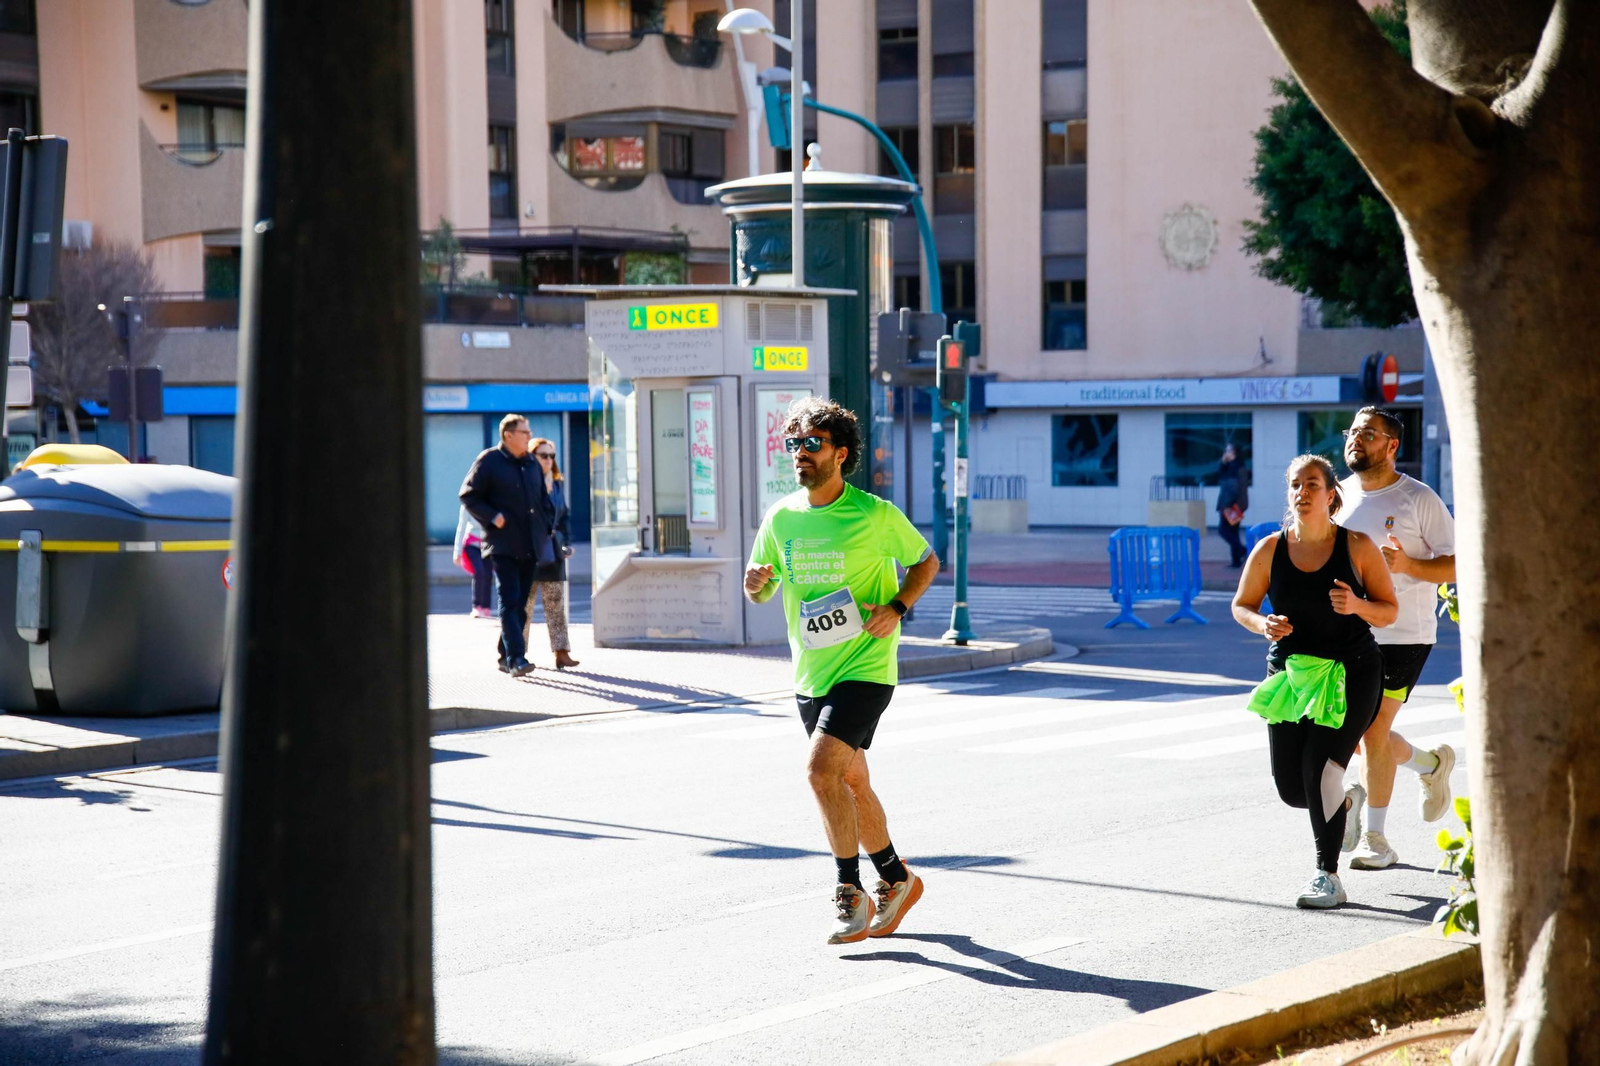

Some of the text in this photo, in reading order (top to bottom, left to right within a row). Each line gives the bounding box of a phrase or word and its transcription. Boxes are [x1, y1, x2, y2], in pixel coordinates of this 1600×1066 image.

[655, 309, 709, 325] ONCE
[769, 352, 802, 366] ONCE
[1080, 384, 1186, 401] traditional food
[784, 539, 793, 584] ALMERÍA
[793, 550, 845, 560] En marcha
[794, 559, 845, 570] contra el
[796, 571, 845, 584] cáncer
[807, 609, 847, 633] 408
